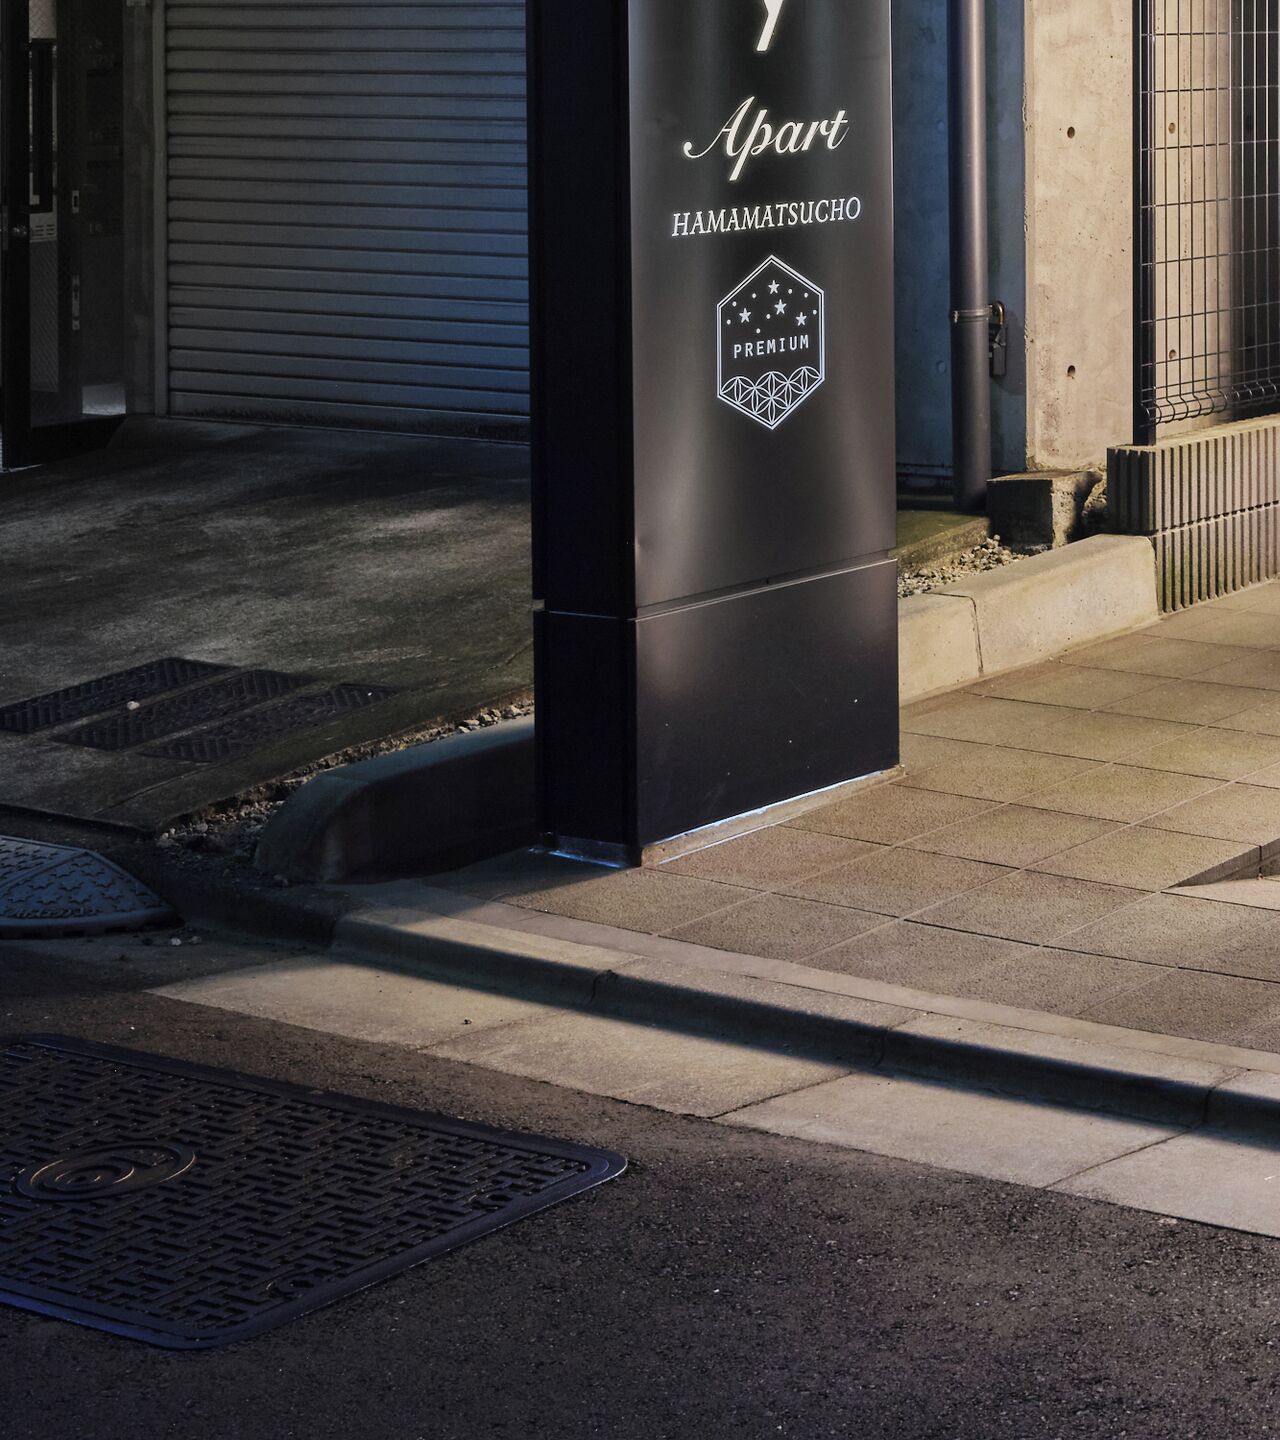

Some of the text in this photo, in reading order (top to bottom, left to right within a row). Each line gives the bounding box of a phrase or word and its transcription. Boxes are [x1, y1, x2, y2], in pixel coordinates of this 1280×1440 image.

[682, 95, 849, 182] Apart
[671, 196, 862, 237] HAMAMATSUCHO
[733, 334, 810, 359] PREMIUM
